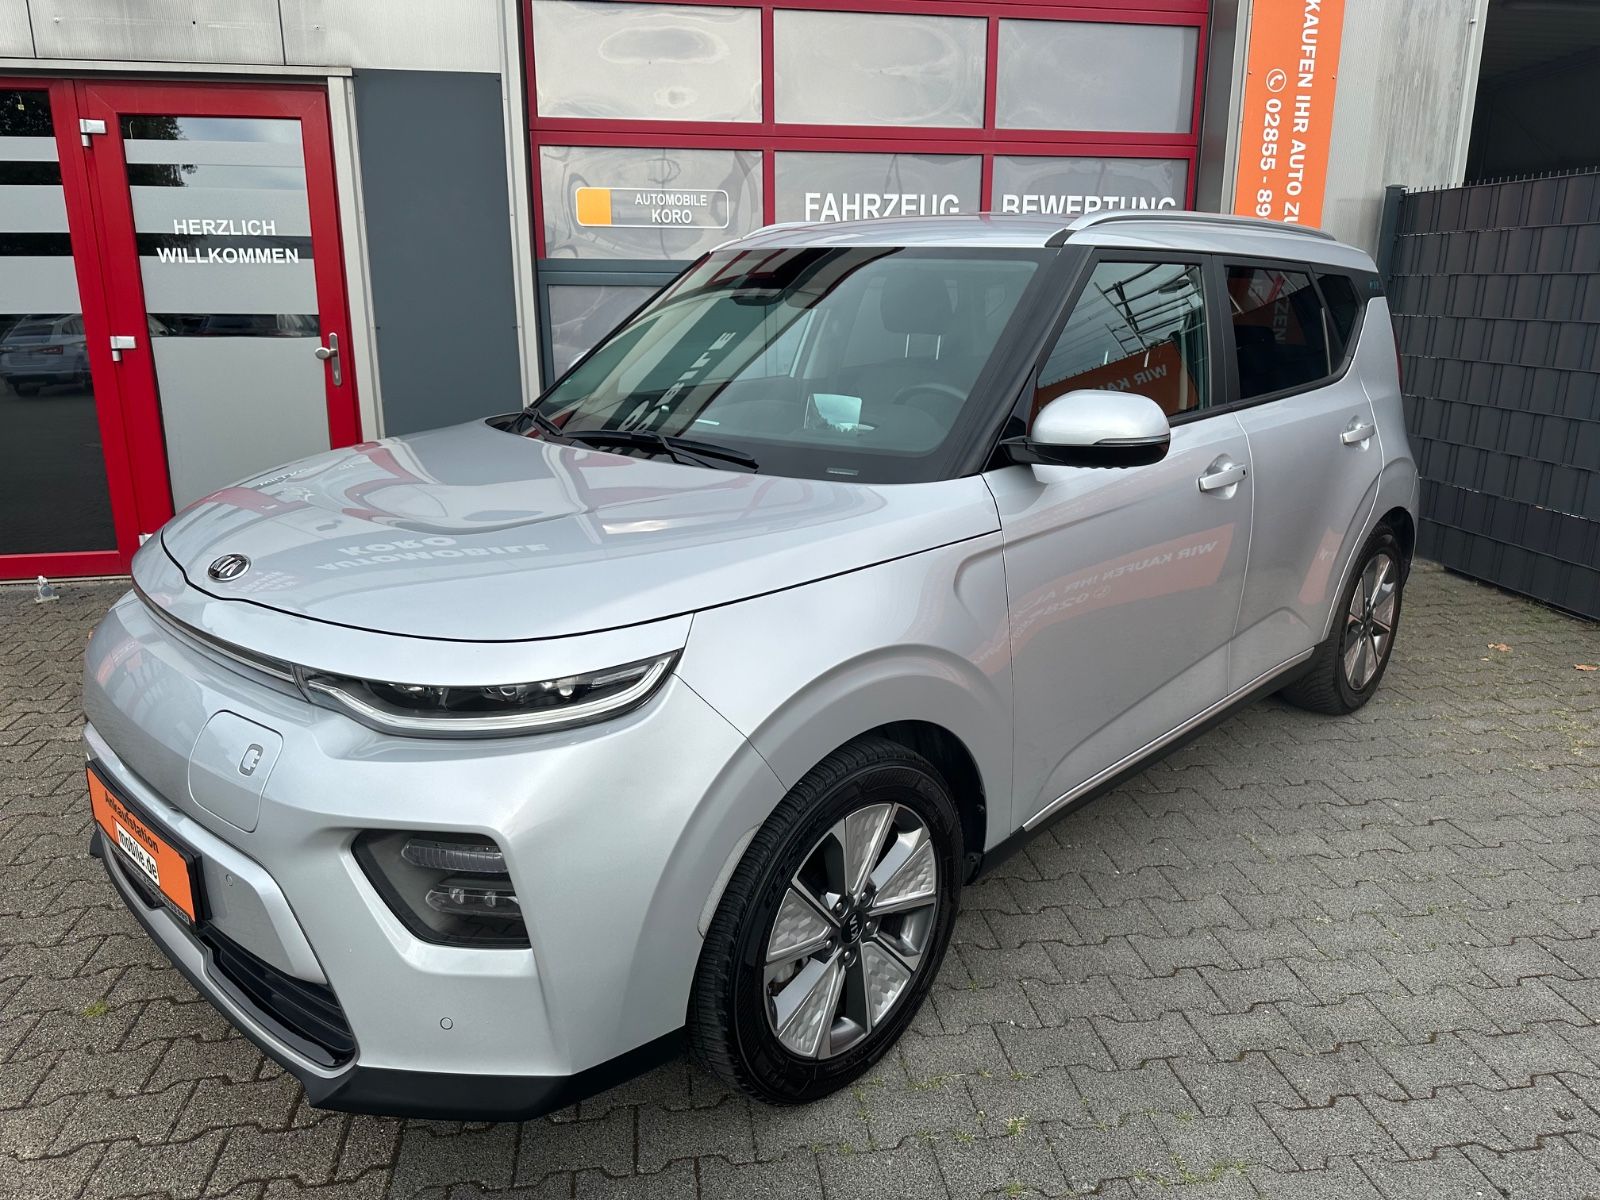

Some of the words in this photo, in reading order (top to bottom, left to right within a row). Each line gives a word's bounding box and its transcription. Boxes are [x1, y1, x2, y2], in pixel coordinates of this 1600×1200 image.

[1298, 0, 1321, 88] KAUFEN
[1293, 95, 1311, 133] IHR
[1260, 98, 1282, 171] 02855
[1286, 139, 1306, 196] AUTO
[634, 193, 708, 207] AUTOMOBILE
[651, 208, 693, 224] KORO
[804, 192, 960, 222] FAHRZEUG
[173, 219, 277, 236] HERZLICH
[156, 247, 300, 264] WILLKOMMEN
[118, 830, 158, 880] mobile.de
